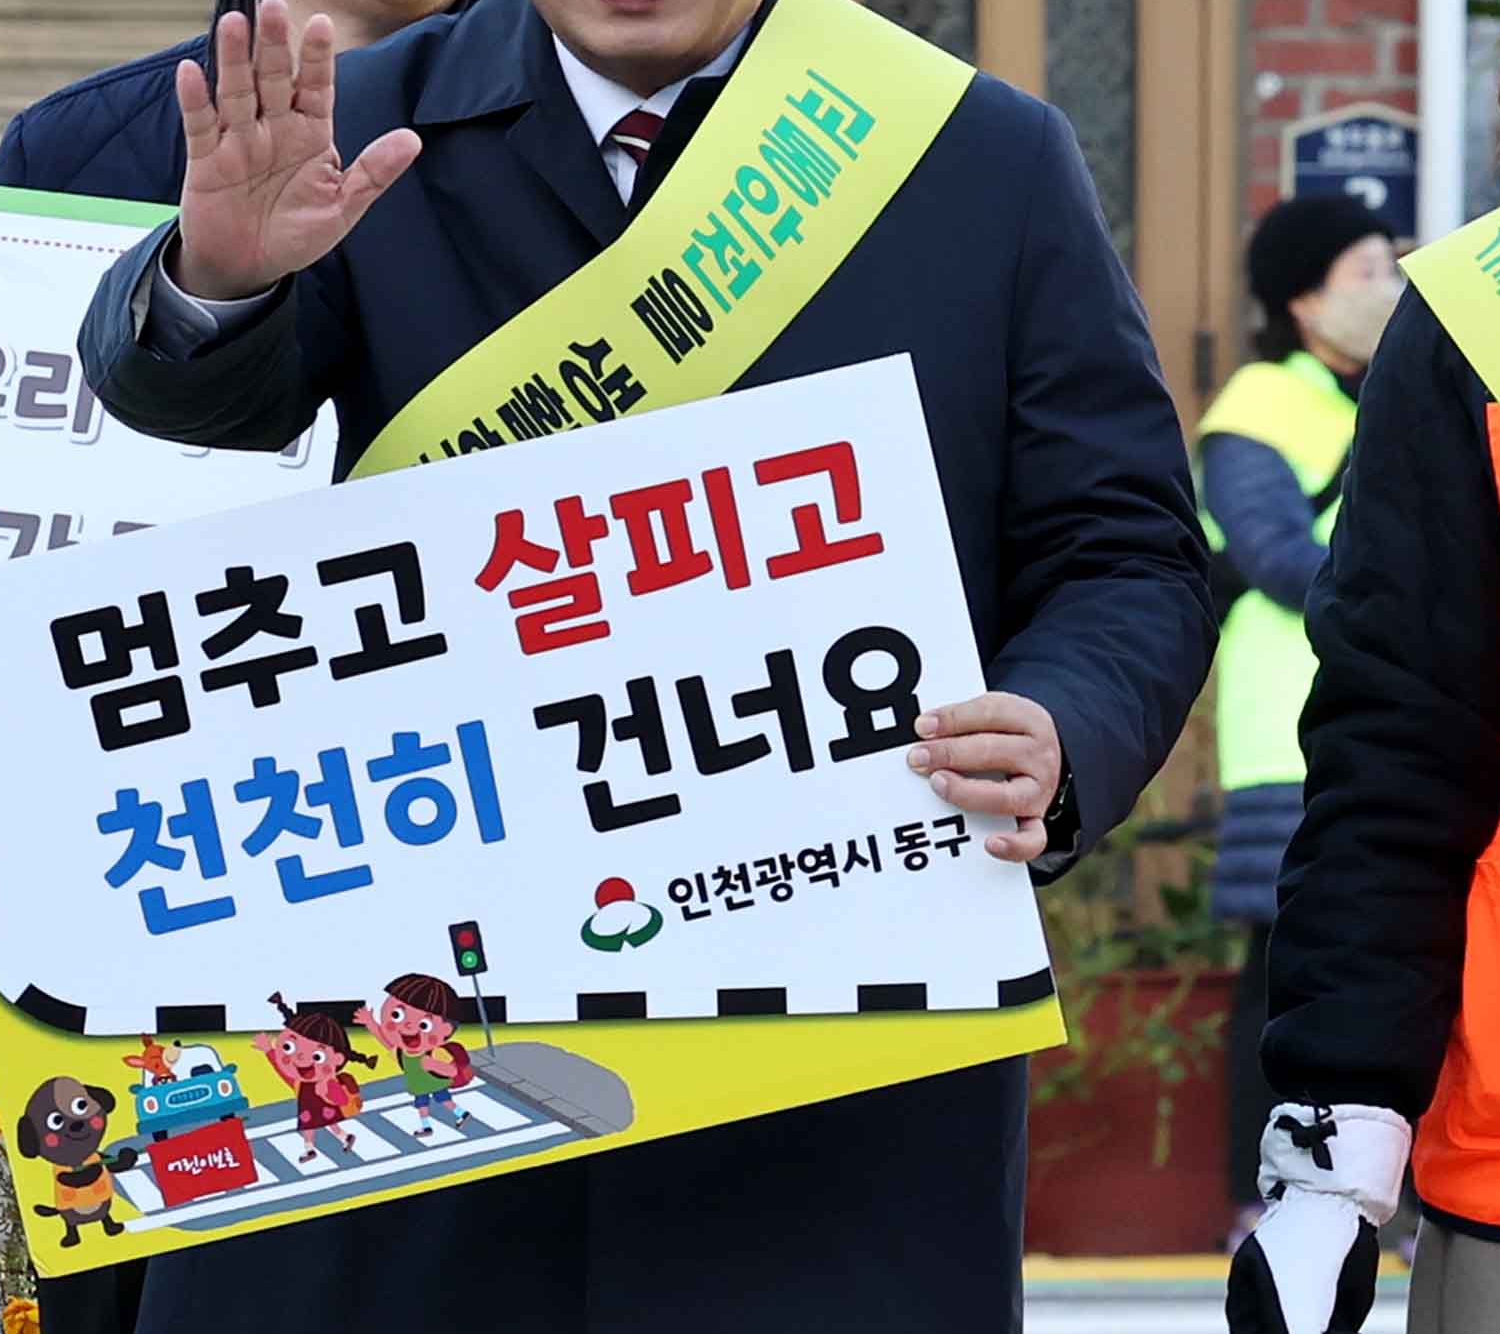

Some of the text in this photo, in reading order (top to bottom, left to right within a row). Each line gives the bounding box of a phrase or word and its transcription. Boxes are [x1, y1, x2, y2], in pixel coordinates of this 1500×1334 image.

[629, 68, 878, 366] 교통안전을
[49, 440, 885, 752] 멈추고 살피고
[96, 624, 926, 936] 천천히 건너요
[666, 814, 973, 922] 인천광역시 동구
